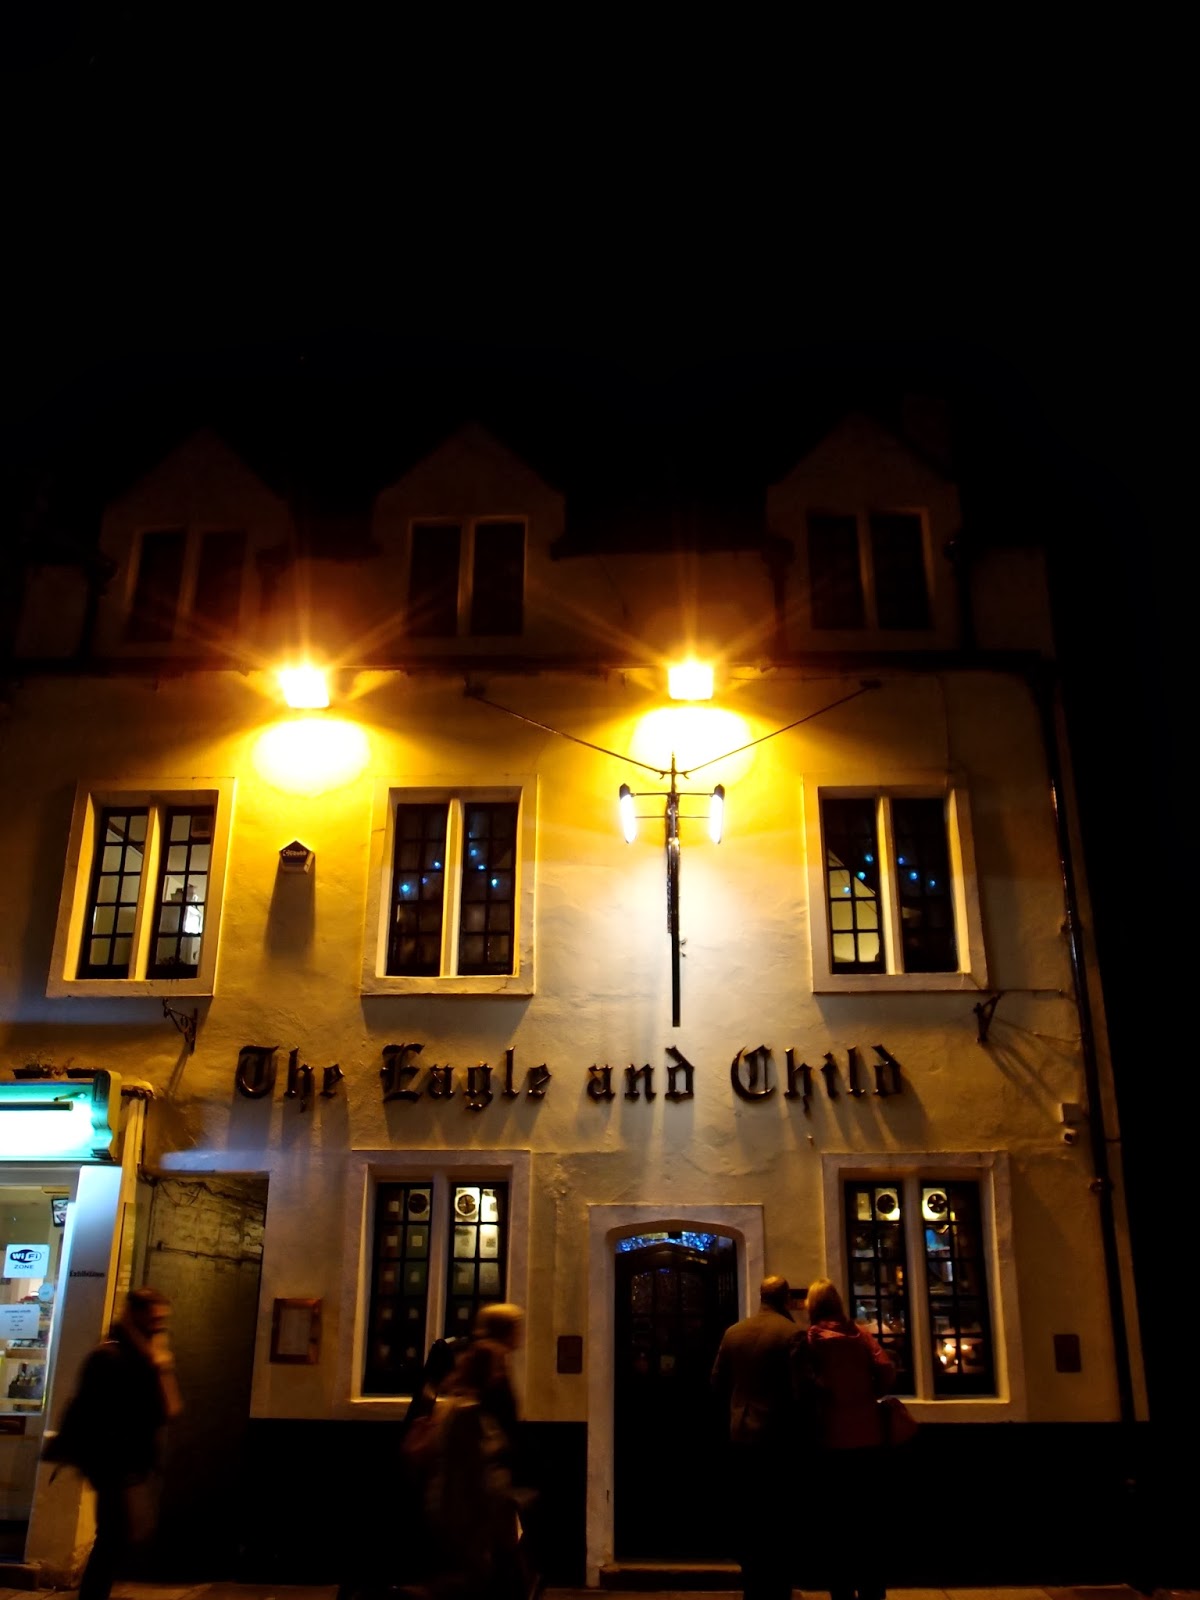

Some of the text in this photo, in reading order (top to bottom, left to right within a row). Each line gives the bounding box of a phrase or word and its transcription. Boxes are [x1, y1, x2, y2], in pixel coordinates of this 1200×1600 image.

[236, 1042, 901, 1117] The Eagle and Child
